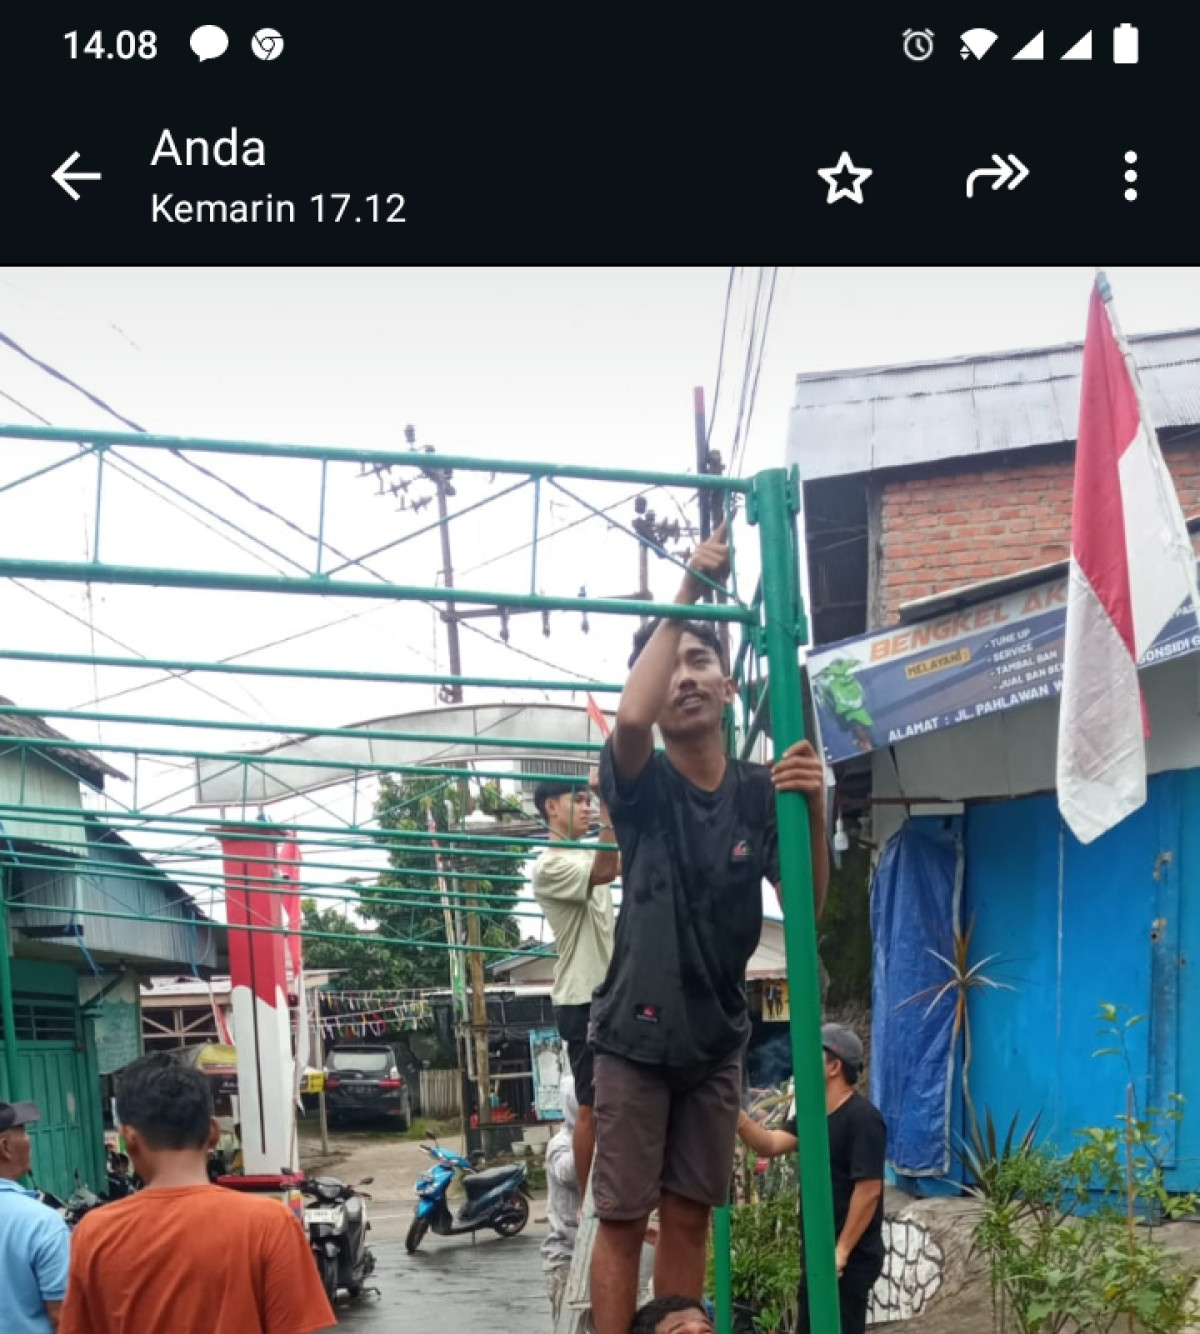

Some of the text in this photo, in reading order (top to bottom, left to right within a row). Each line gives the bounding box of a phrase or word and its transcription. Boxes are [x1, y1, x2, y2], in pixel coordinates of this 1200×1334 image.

[869, 604, 1011, 662] BENGKEL
[992, 642, 1032, 662] SERVICE
[996, 649, 1058, 675] TAMBAL BAN
[1000, 674, 1024, 690] JUAL
[1025, 668, 1047, 683] BAN
[887, 716, 939, 743] ALAMAT
[954, 708, 976, 723] JL.
[975, 683, 1050, 717] PAHLAWAN
